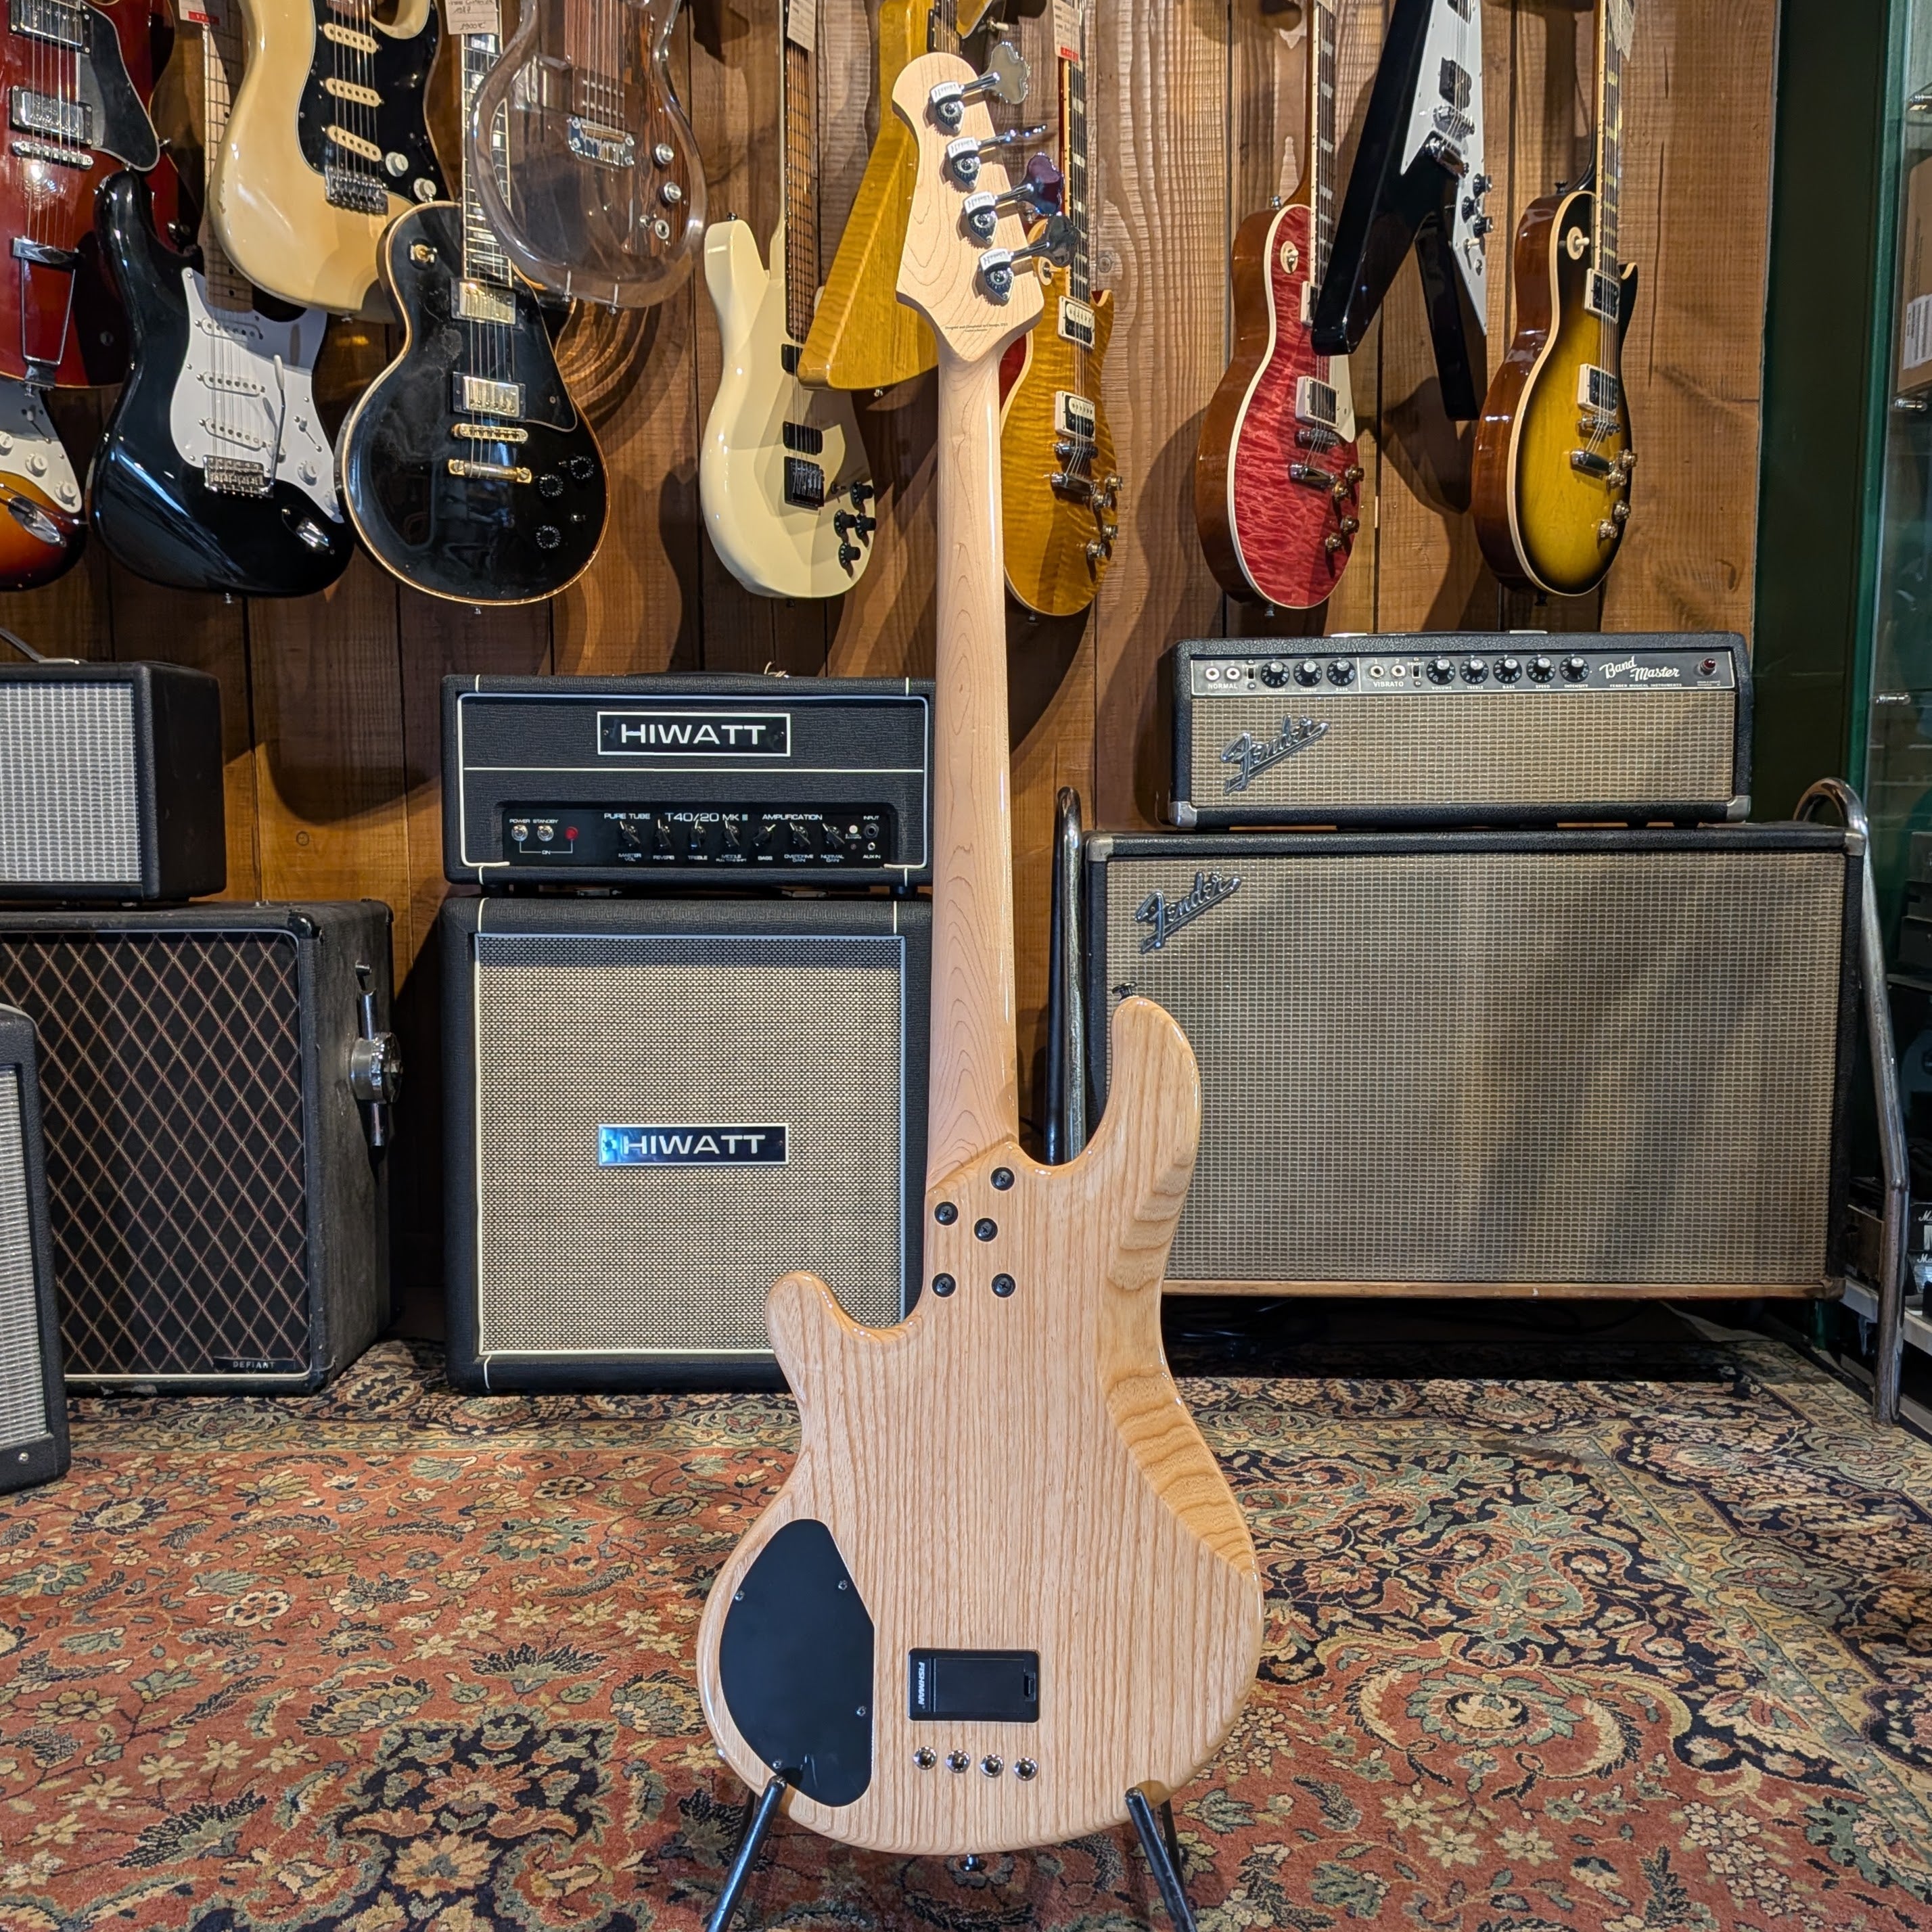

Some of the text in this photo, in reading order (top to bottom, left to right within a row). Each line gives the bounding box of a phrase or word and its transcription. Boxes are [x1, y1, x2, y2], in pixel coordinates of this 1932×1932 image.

[1599, 656, 1637, 679] Band
[621, 723, 766, 745] HIWATT
[1220, 712, 1331, 795] Fender
[664, 812, 719, 822] T40/20
[1134, 871, 1242, 954] Fender
[622, 1134, 766, 1154] HIWATT
[233, 1361, 275, 1369] DEFIANT
